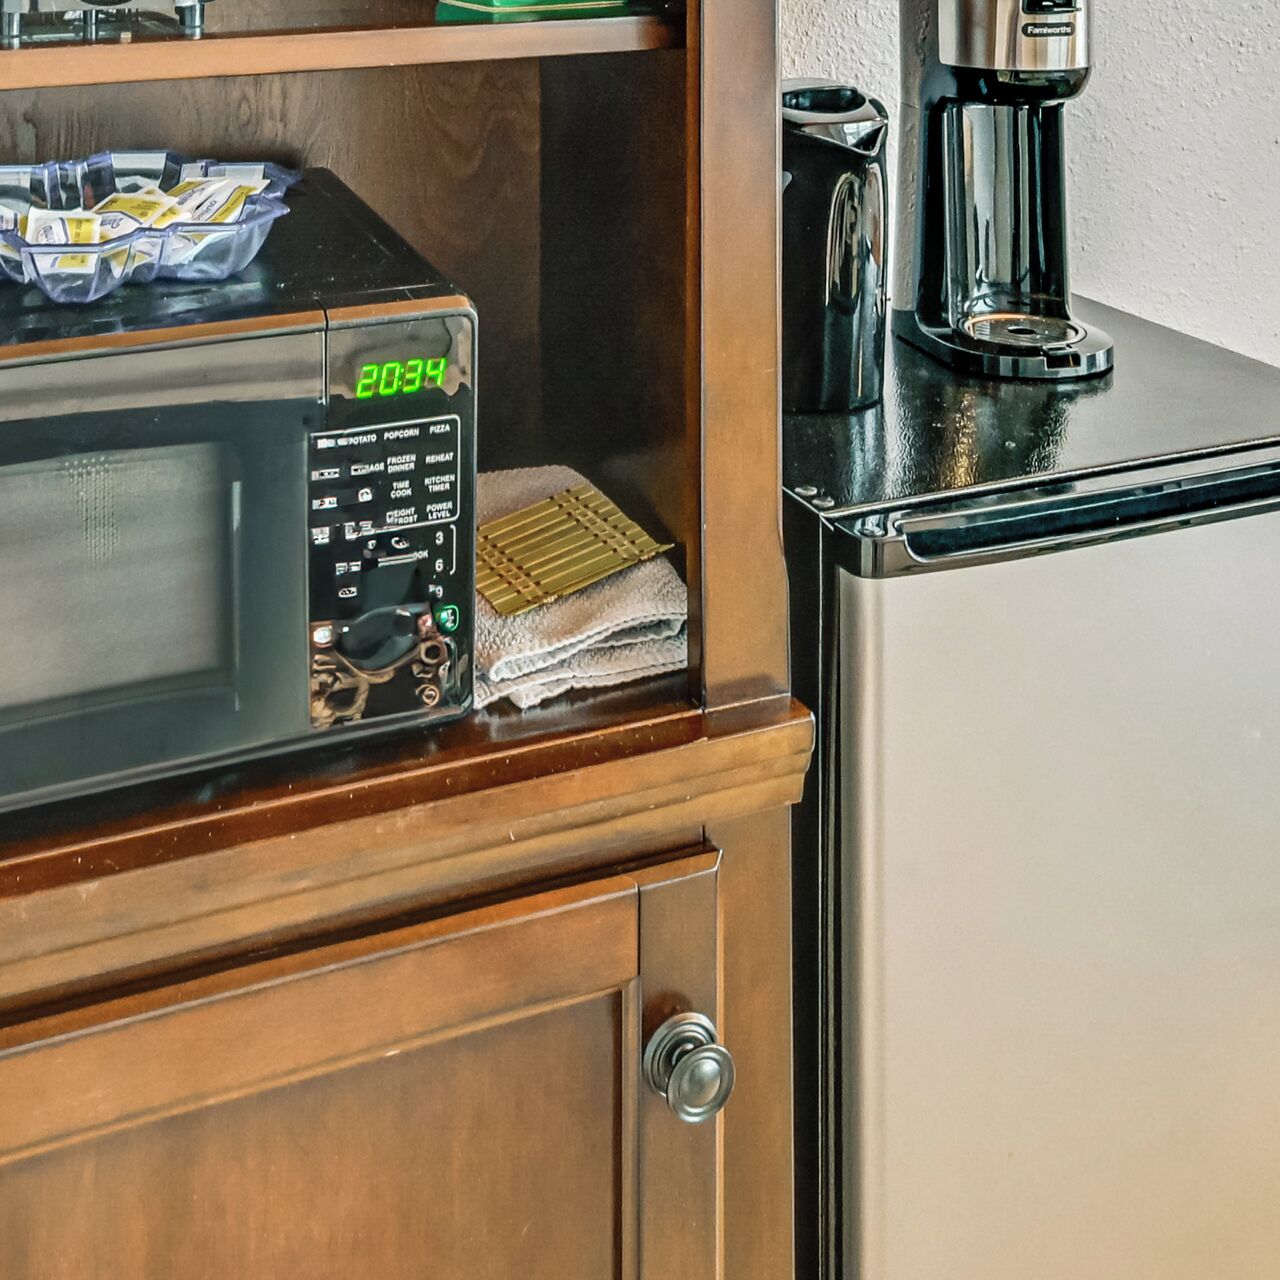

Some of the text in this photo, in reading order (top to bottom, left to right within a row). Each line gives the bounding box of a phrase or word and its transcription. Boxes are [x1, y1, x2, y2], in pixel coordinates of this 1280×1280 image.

[356, 357, 447, 399] 20:34
[384, 428, 420, 440] POPCORN
[429, 423, 451, 435] PIZZA
[387, 454, 417, 466] FROZEN
[426, 452, 454, 464] REHEAT
[388, 463, 415, 474] DINNER
[393, 480, 410, 489] TIME
[425, 474, 456, 485] KITCHEN
[390, 489, 412, 499] COOK
[429, 483, 451, 493] TIMER
[426, 501, 453, 512] POWER
[428, 510, 451, 520] LEVEL
[435, 531, 444, 545] 3
[435, 558, 444, 573] 6
[435, 586, 444, 599] 9
